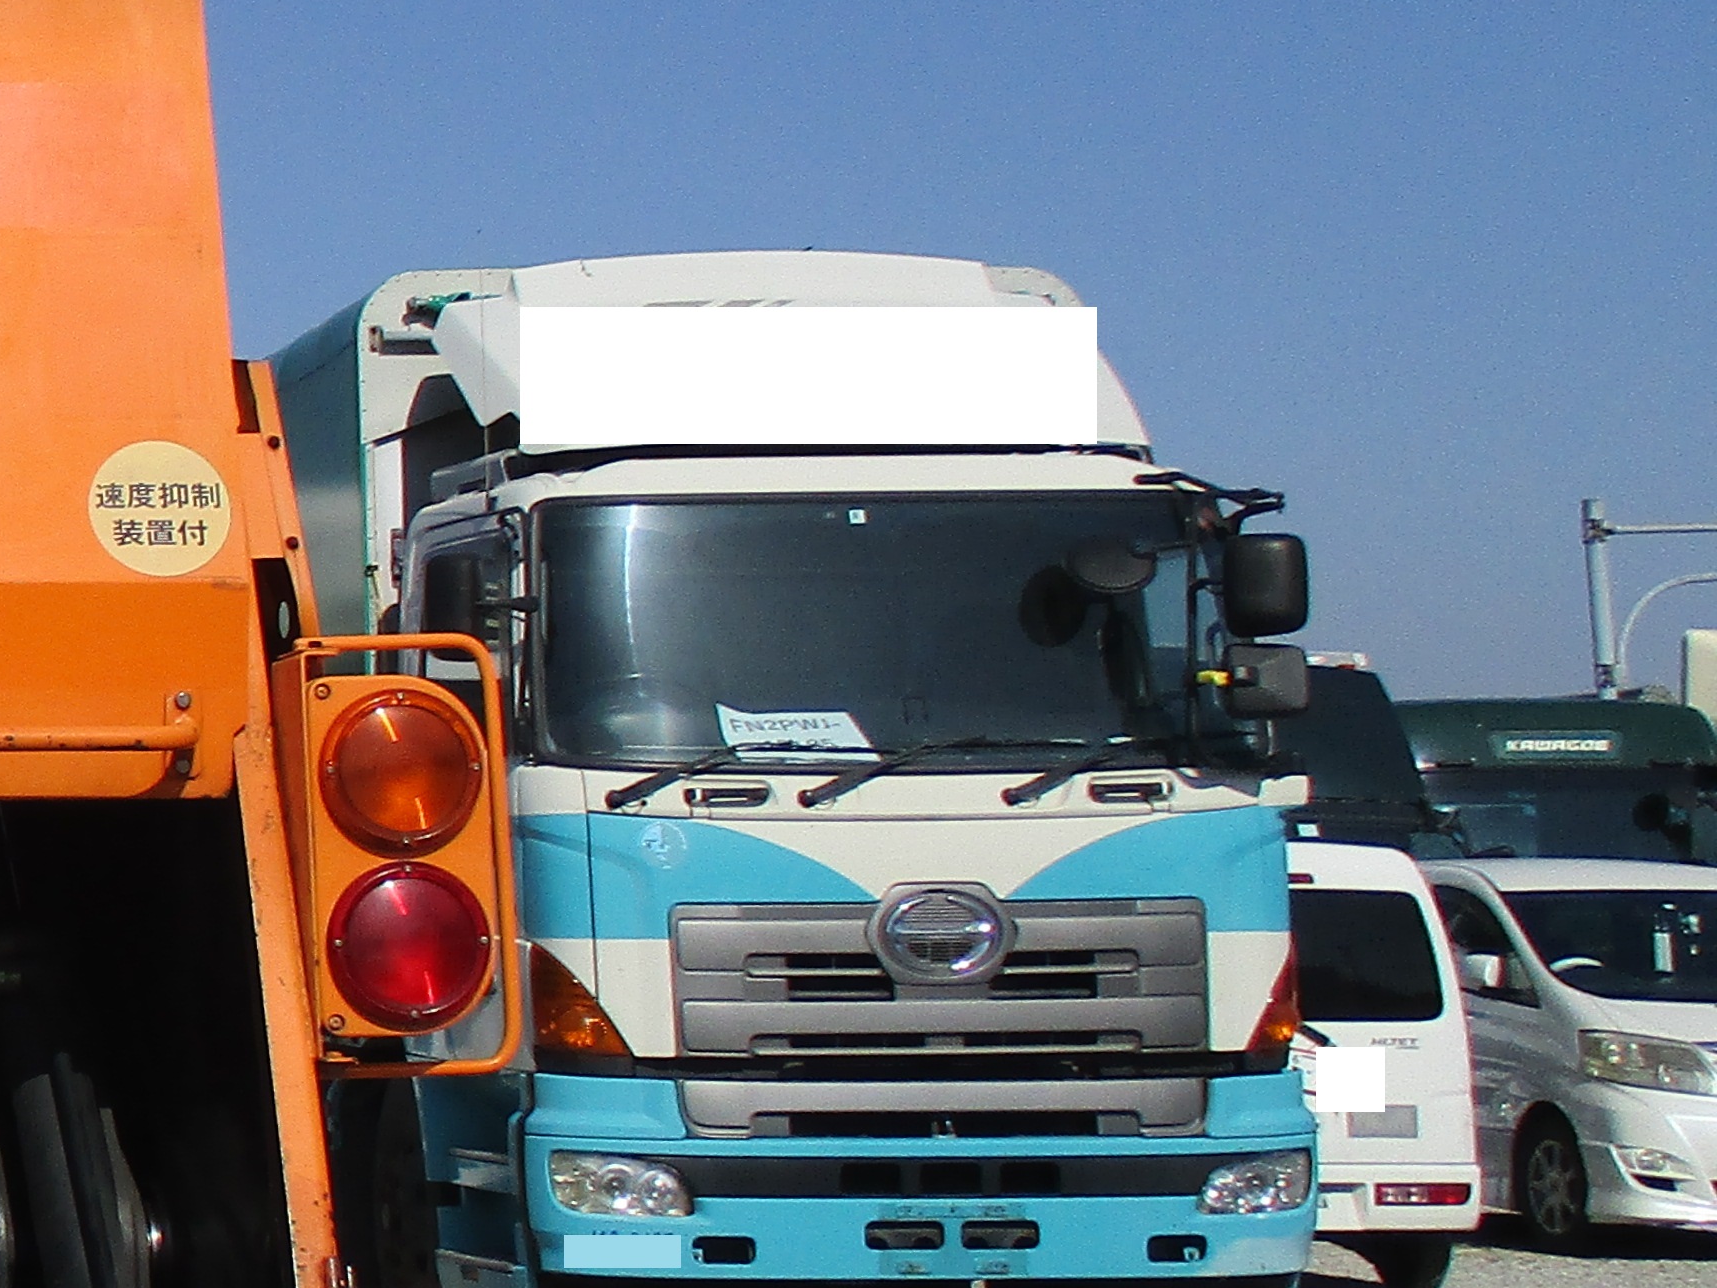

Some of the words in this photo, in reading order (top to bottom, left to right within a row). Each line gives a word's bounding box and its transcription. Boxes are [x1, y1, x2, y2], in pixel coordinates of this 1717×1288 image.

[95, 482, 222, 509] 速度抑制
[113, 519, 209, 547] 装置付
